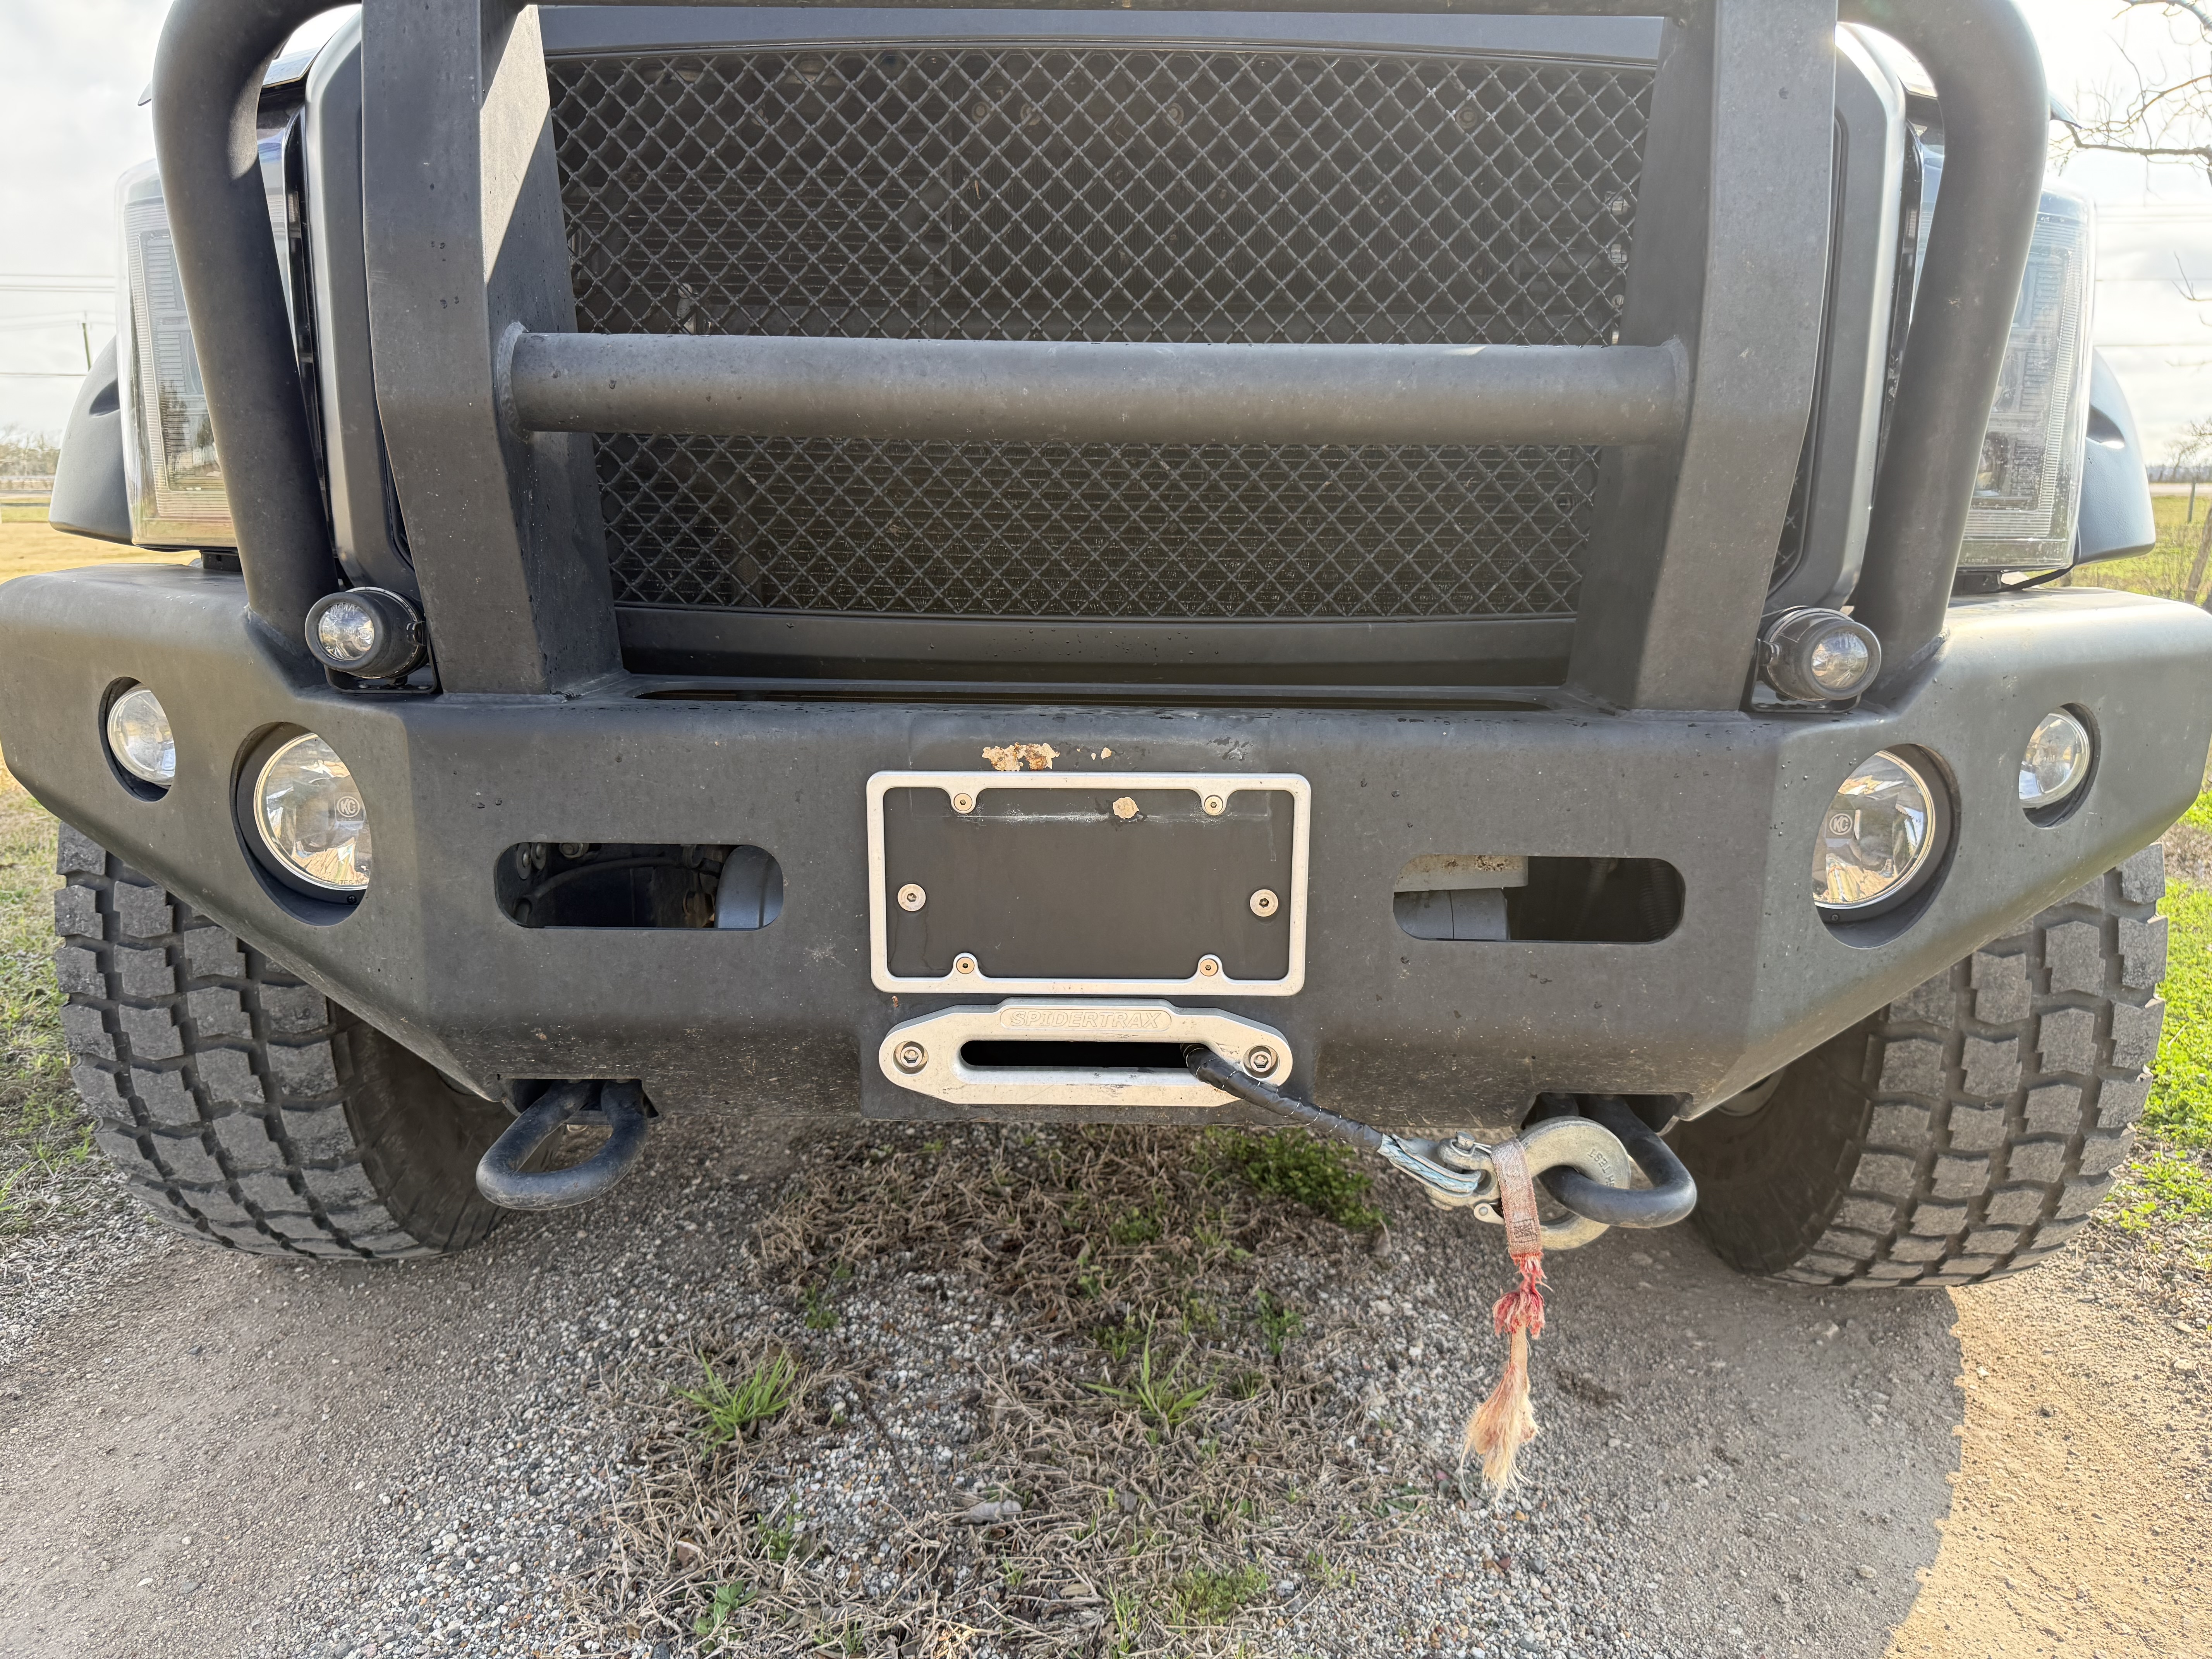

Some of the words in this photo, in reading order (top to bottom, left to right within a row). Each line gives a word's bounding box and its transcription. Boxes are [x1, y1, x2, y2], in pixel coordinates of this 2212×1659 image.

[340, 798, 356, 816] KC
[1832, 815, 1849, 833] KC
[1010, 1010, 1161, 1029] SPIDERTRAX
[1587, 1148, 1611, 1174] TEST
